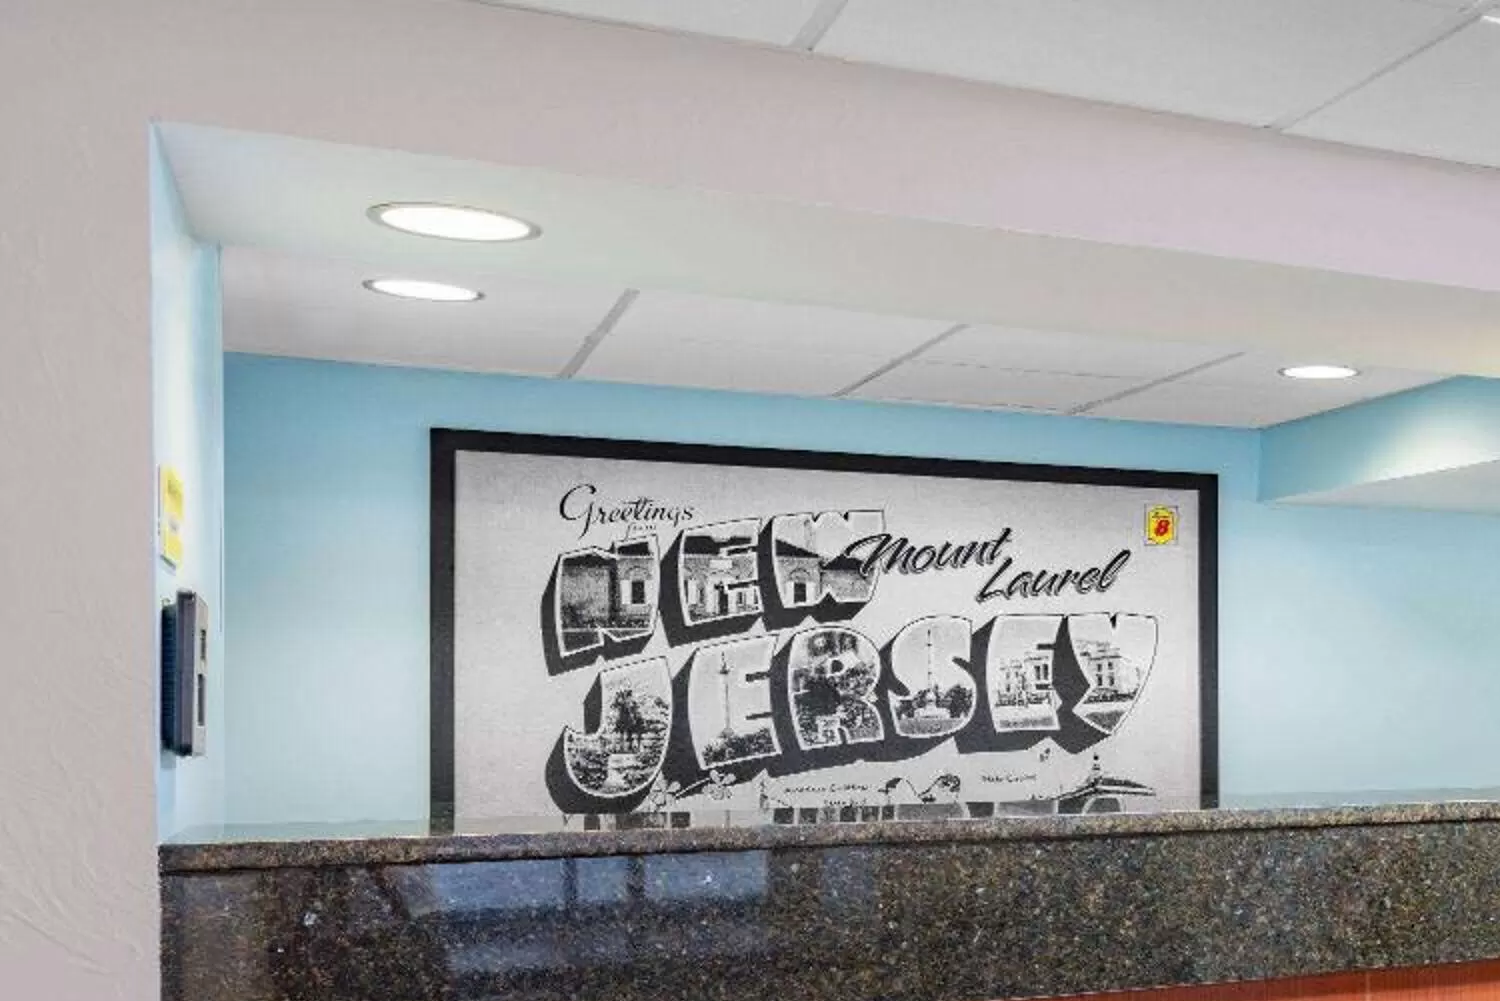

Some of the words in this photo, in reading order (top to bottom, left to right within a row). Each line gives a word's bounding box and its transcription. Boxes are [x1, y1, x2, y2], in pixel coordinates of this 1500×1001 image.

[559, 483, 695, 540] Greetings
[1154, 519, 1170, 537] 8
[845, 527, 1012, 577] Mount
[975, 548, 1132, 603] Laurel
[543, 507, 886, 672] NEW
[547, 612, 1160, 811] JERSEY
